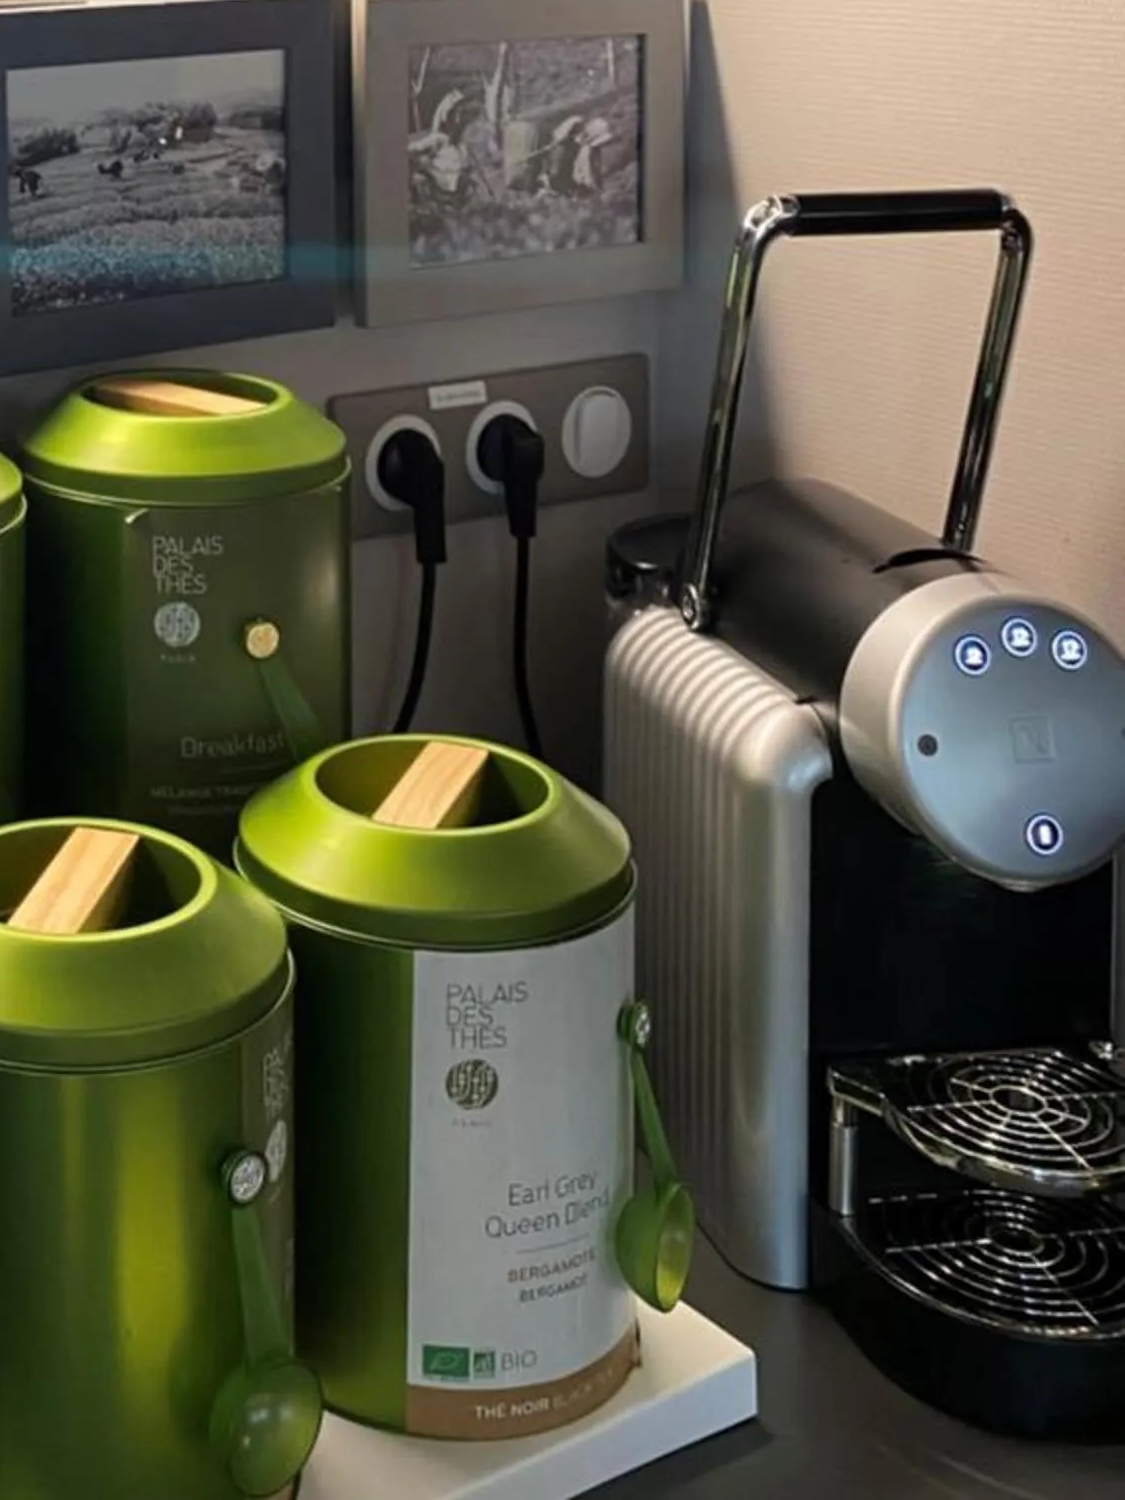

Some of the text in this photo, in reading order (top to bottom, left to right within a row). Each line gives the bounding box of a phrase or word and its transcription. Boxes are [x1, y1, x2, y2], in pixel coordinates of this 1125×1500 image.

[151, 535, 224, 557] PALAIS
[152, 554, 194, 576] DES
[446, 980, 531, 1007] PALAIS
[446, 1003, 494, 1029] DES
[508, 1170, 597, 1207] Earl Grey
[485, 1210, 561, 1239] Queen
[507, 1245, 596, 1284] BERGAMOTE
[500, 1349, 539, 1374] BIO
[509, 1396, 551, 1418] NOIR
